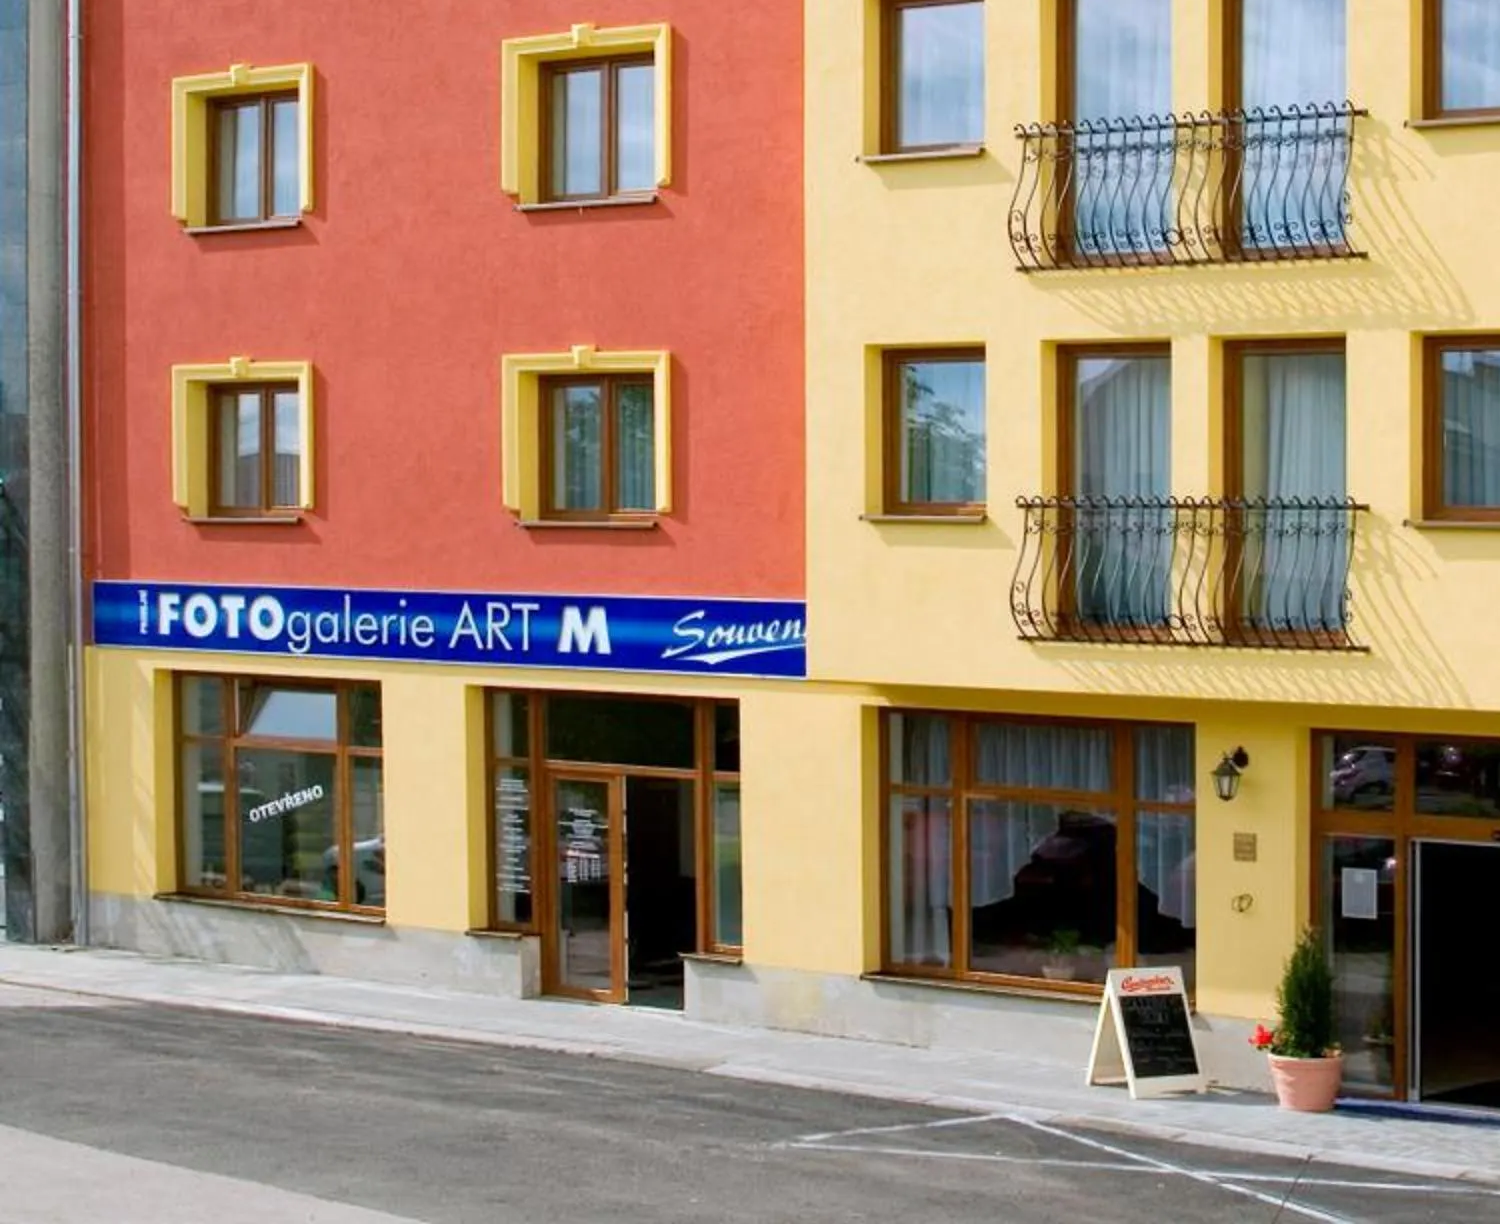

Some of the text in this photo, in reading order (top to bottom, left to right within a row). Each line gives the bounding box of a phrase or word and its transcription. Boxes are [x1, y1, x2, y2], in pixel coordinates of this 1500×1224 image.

[158, 593, 435, 653] FOTOgalerie
[449, 601, 540, 651] ART
[558, 606, 612, 654] M
[660, 609, 807, 659] Souven
